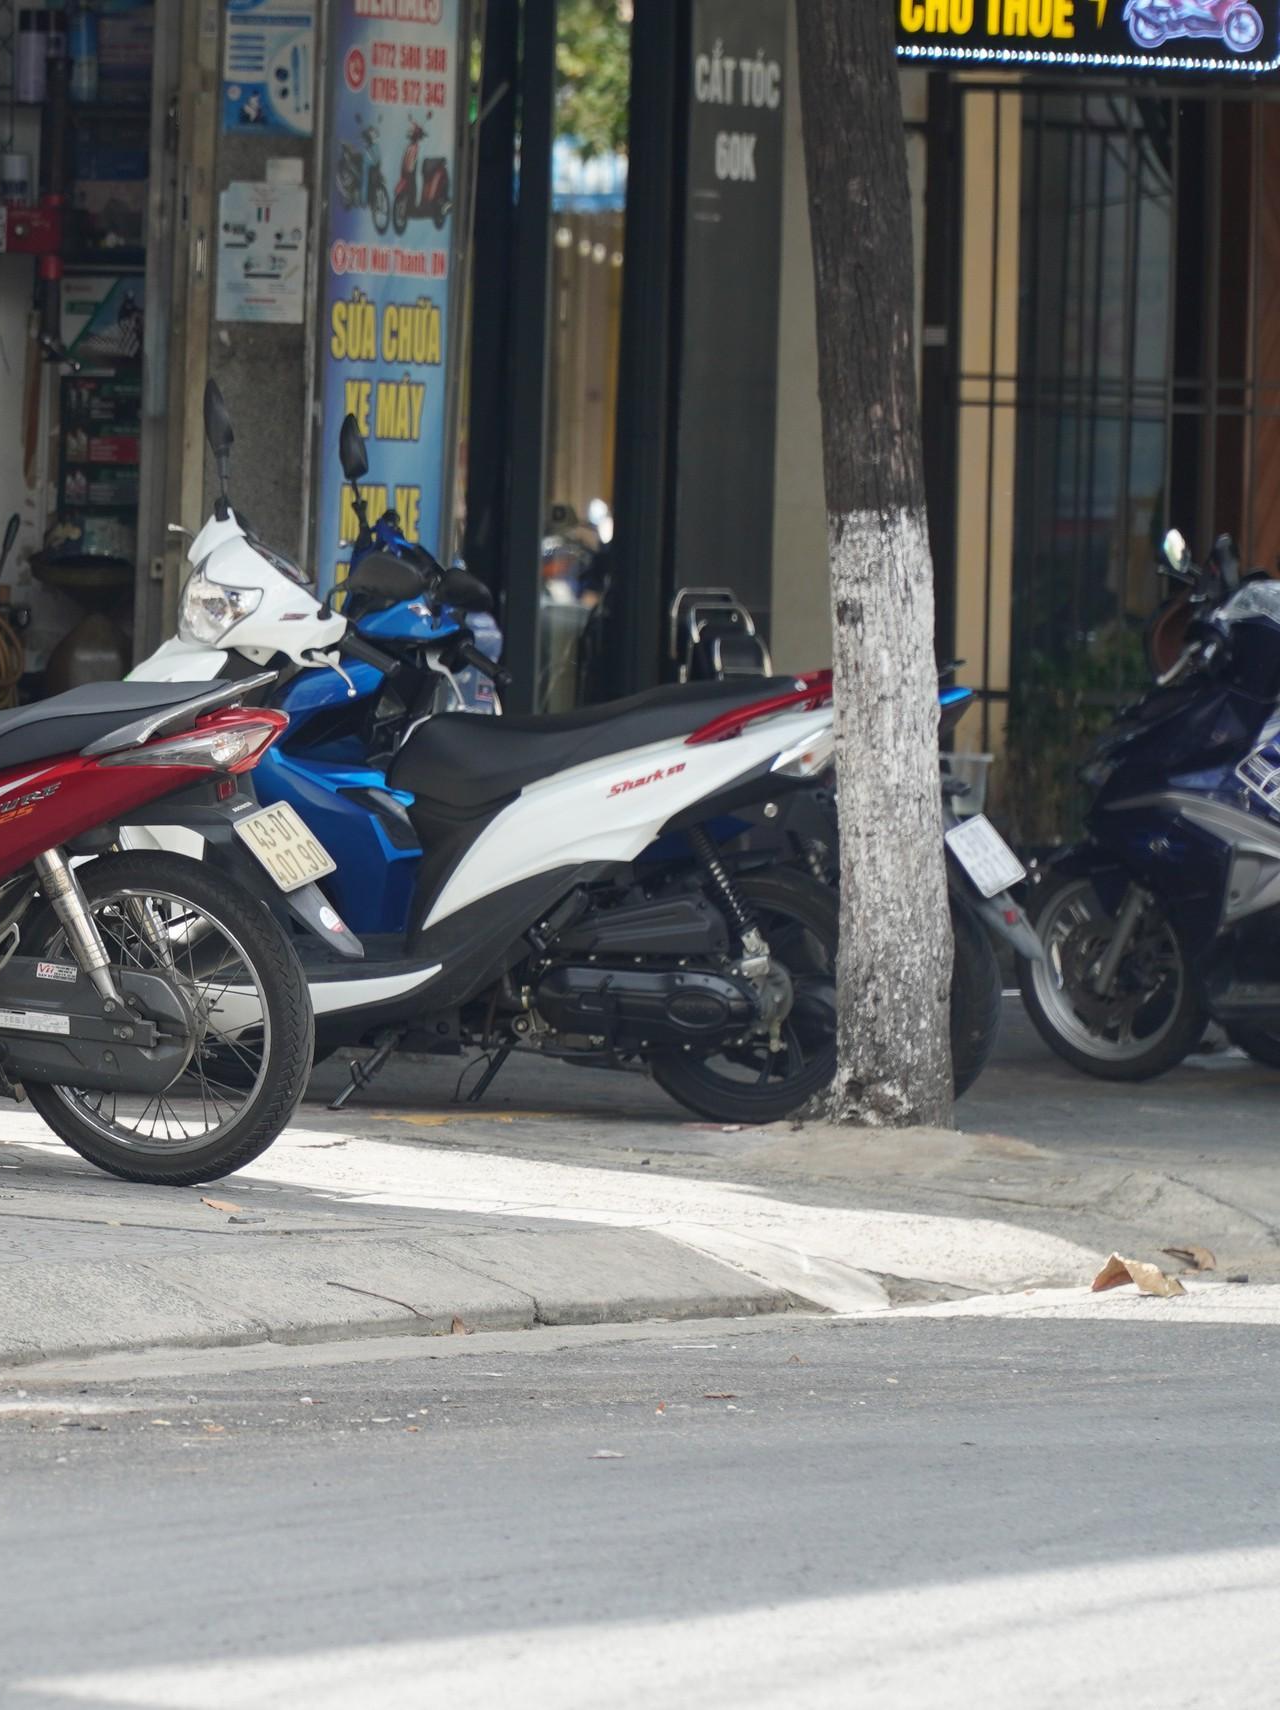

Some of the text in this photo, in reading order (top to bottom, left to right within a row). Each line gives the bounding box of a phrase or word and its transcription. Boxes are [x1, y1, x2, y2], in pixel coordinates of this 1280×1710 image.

[694, 38, 782, 109] CẮT TÓC
[715, 131, 757, 182] 60K
[331, 288, 377, 361] SỬA
[382, 297, 442, 366] CHỮA
[375, 373, 426, 442] MÁY
[606, 768, 663, 799] Shark
[266, 839, 330, 885] 407.90
